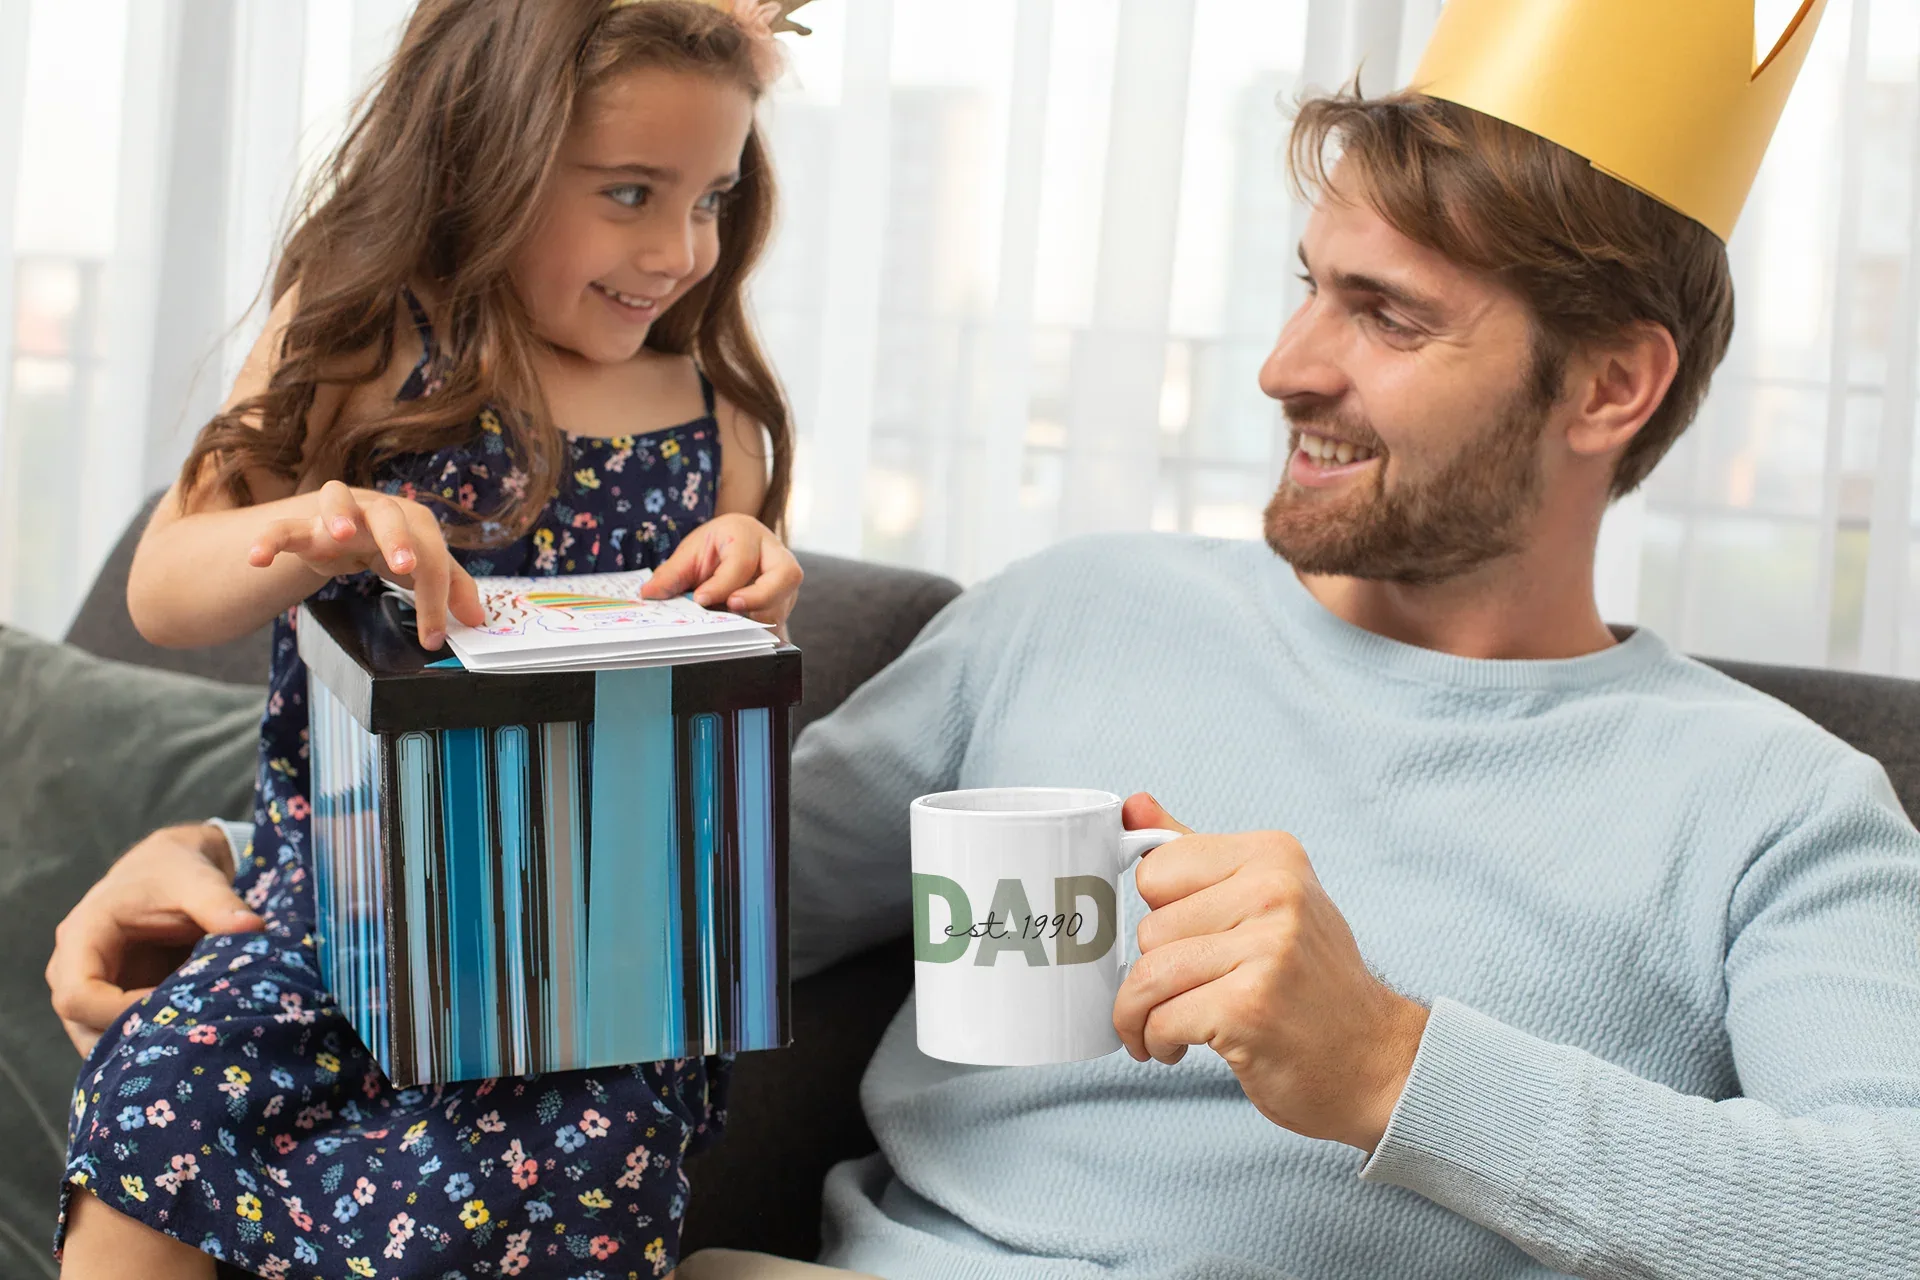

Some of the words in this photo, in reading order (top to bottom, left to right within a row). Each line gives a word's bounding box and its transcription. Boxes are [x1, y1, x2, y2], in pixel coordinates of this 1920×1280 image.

[912, 872, 1117, 967] DAD
[944, 911, 1011, 940] est.
[1022, 912, 1083, 939] 1990
